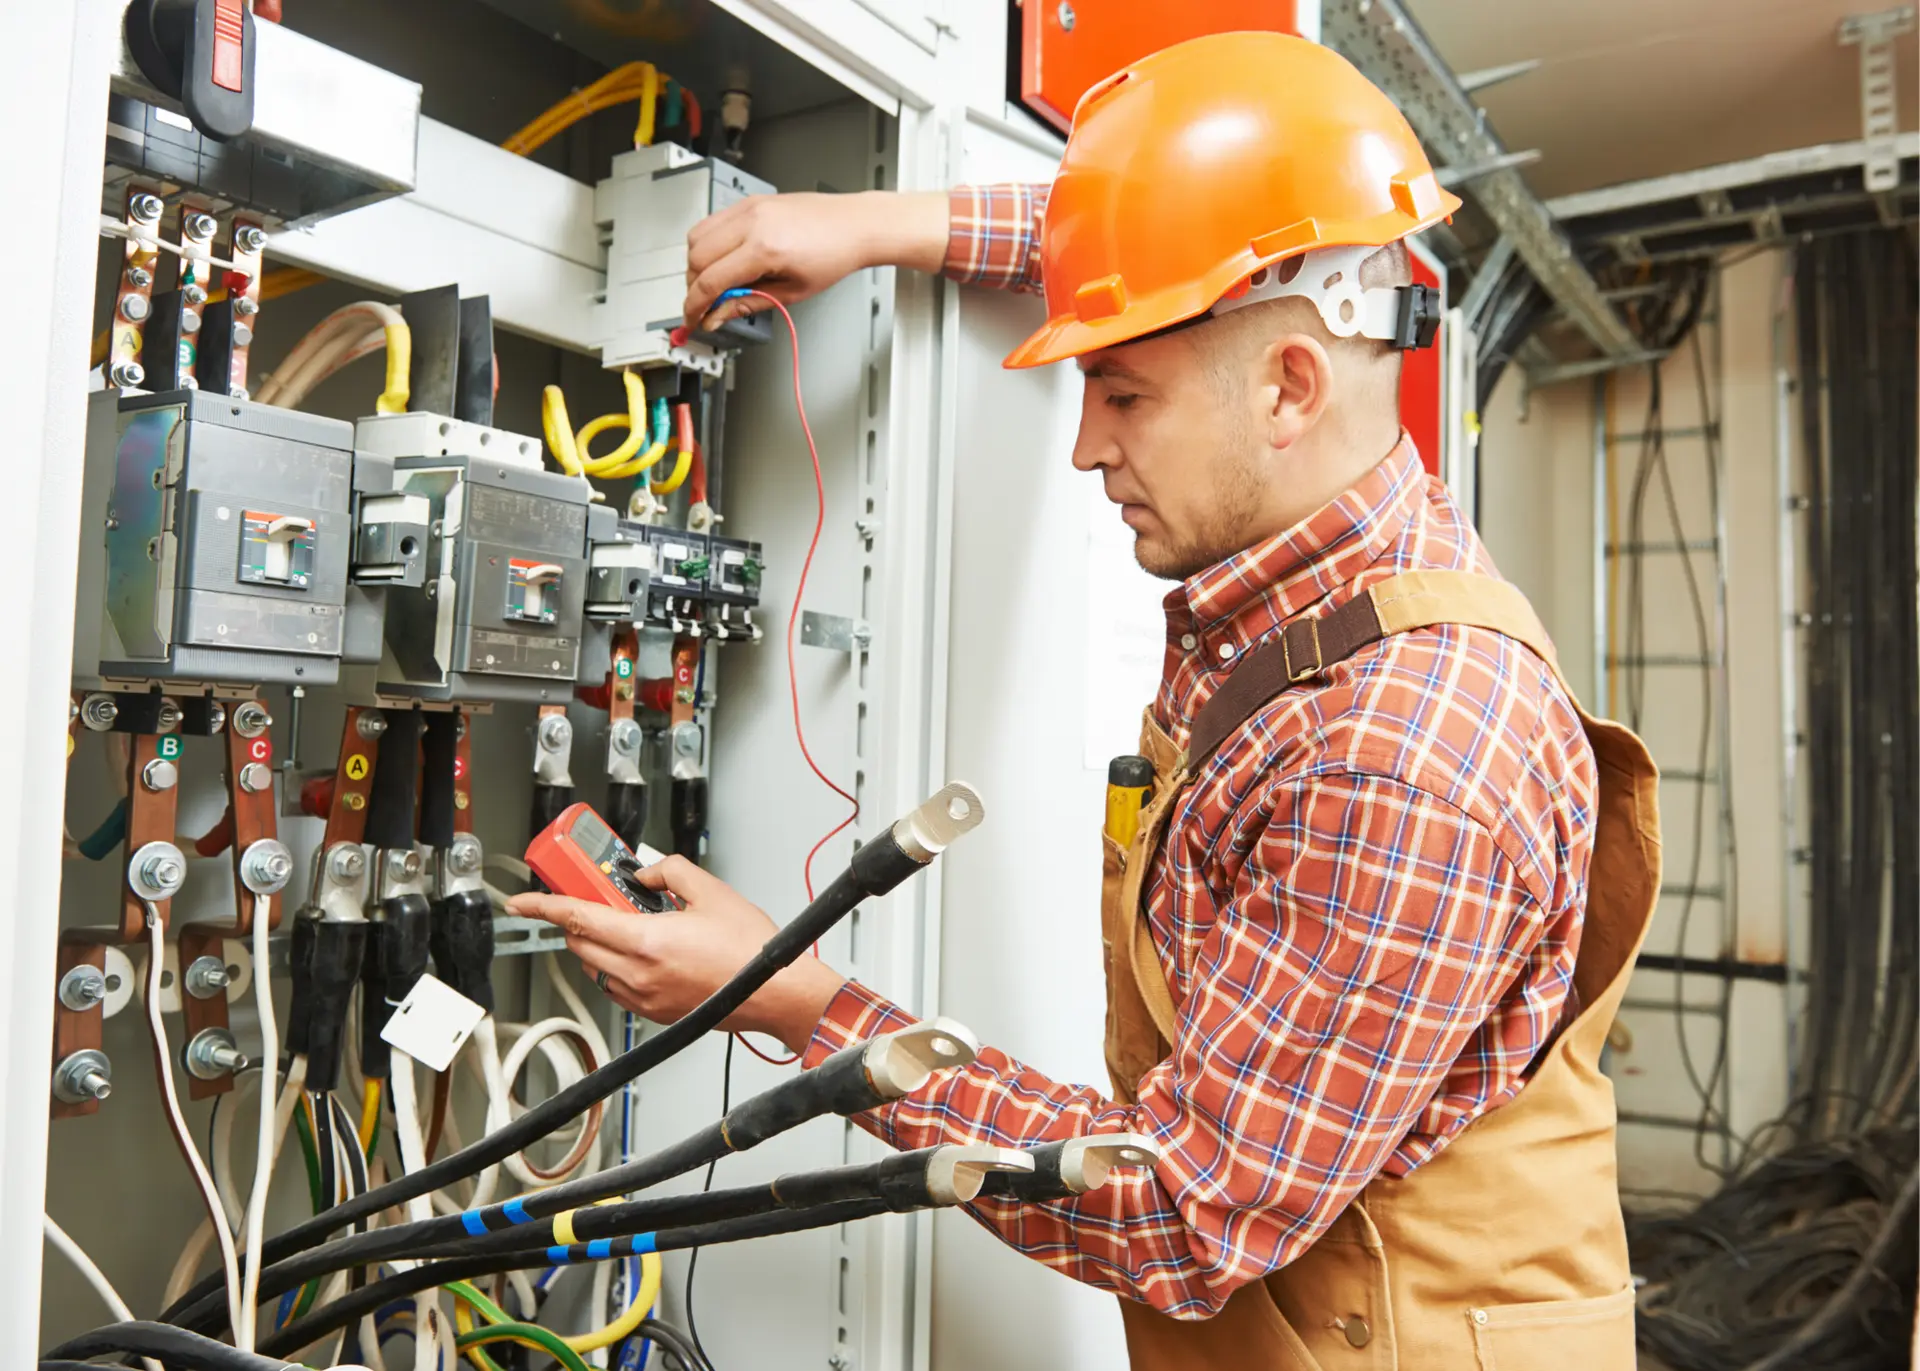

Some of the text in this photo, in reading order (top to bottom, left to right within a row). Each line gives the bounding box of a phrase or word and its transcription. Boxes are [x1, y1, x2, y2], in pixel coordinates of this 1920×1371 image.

[120, 331, 137, 349] A
[179, 344, 191, 363] B
[619, 660, 631, 676] B
[679, 668, 689, 682] C
[162, 737, 178, 756] B
[252, 740, 266, 759] C
[351, 758, 364, 775] A
